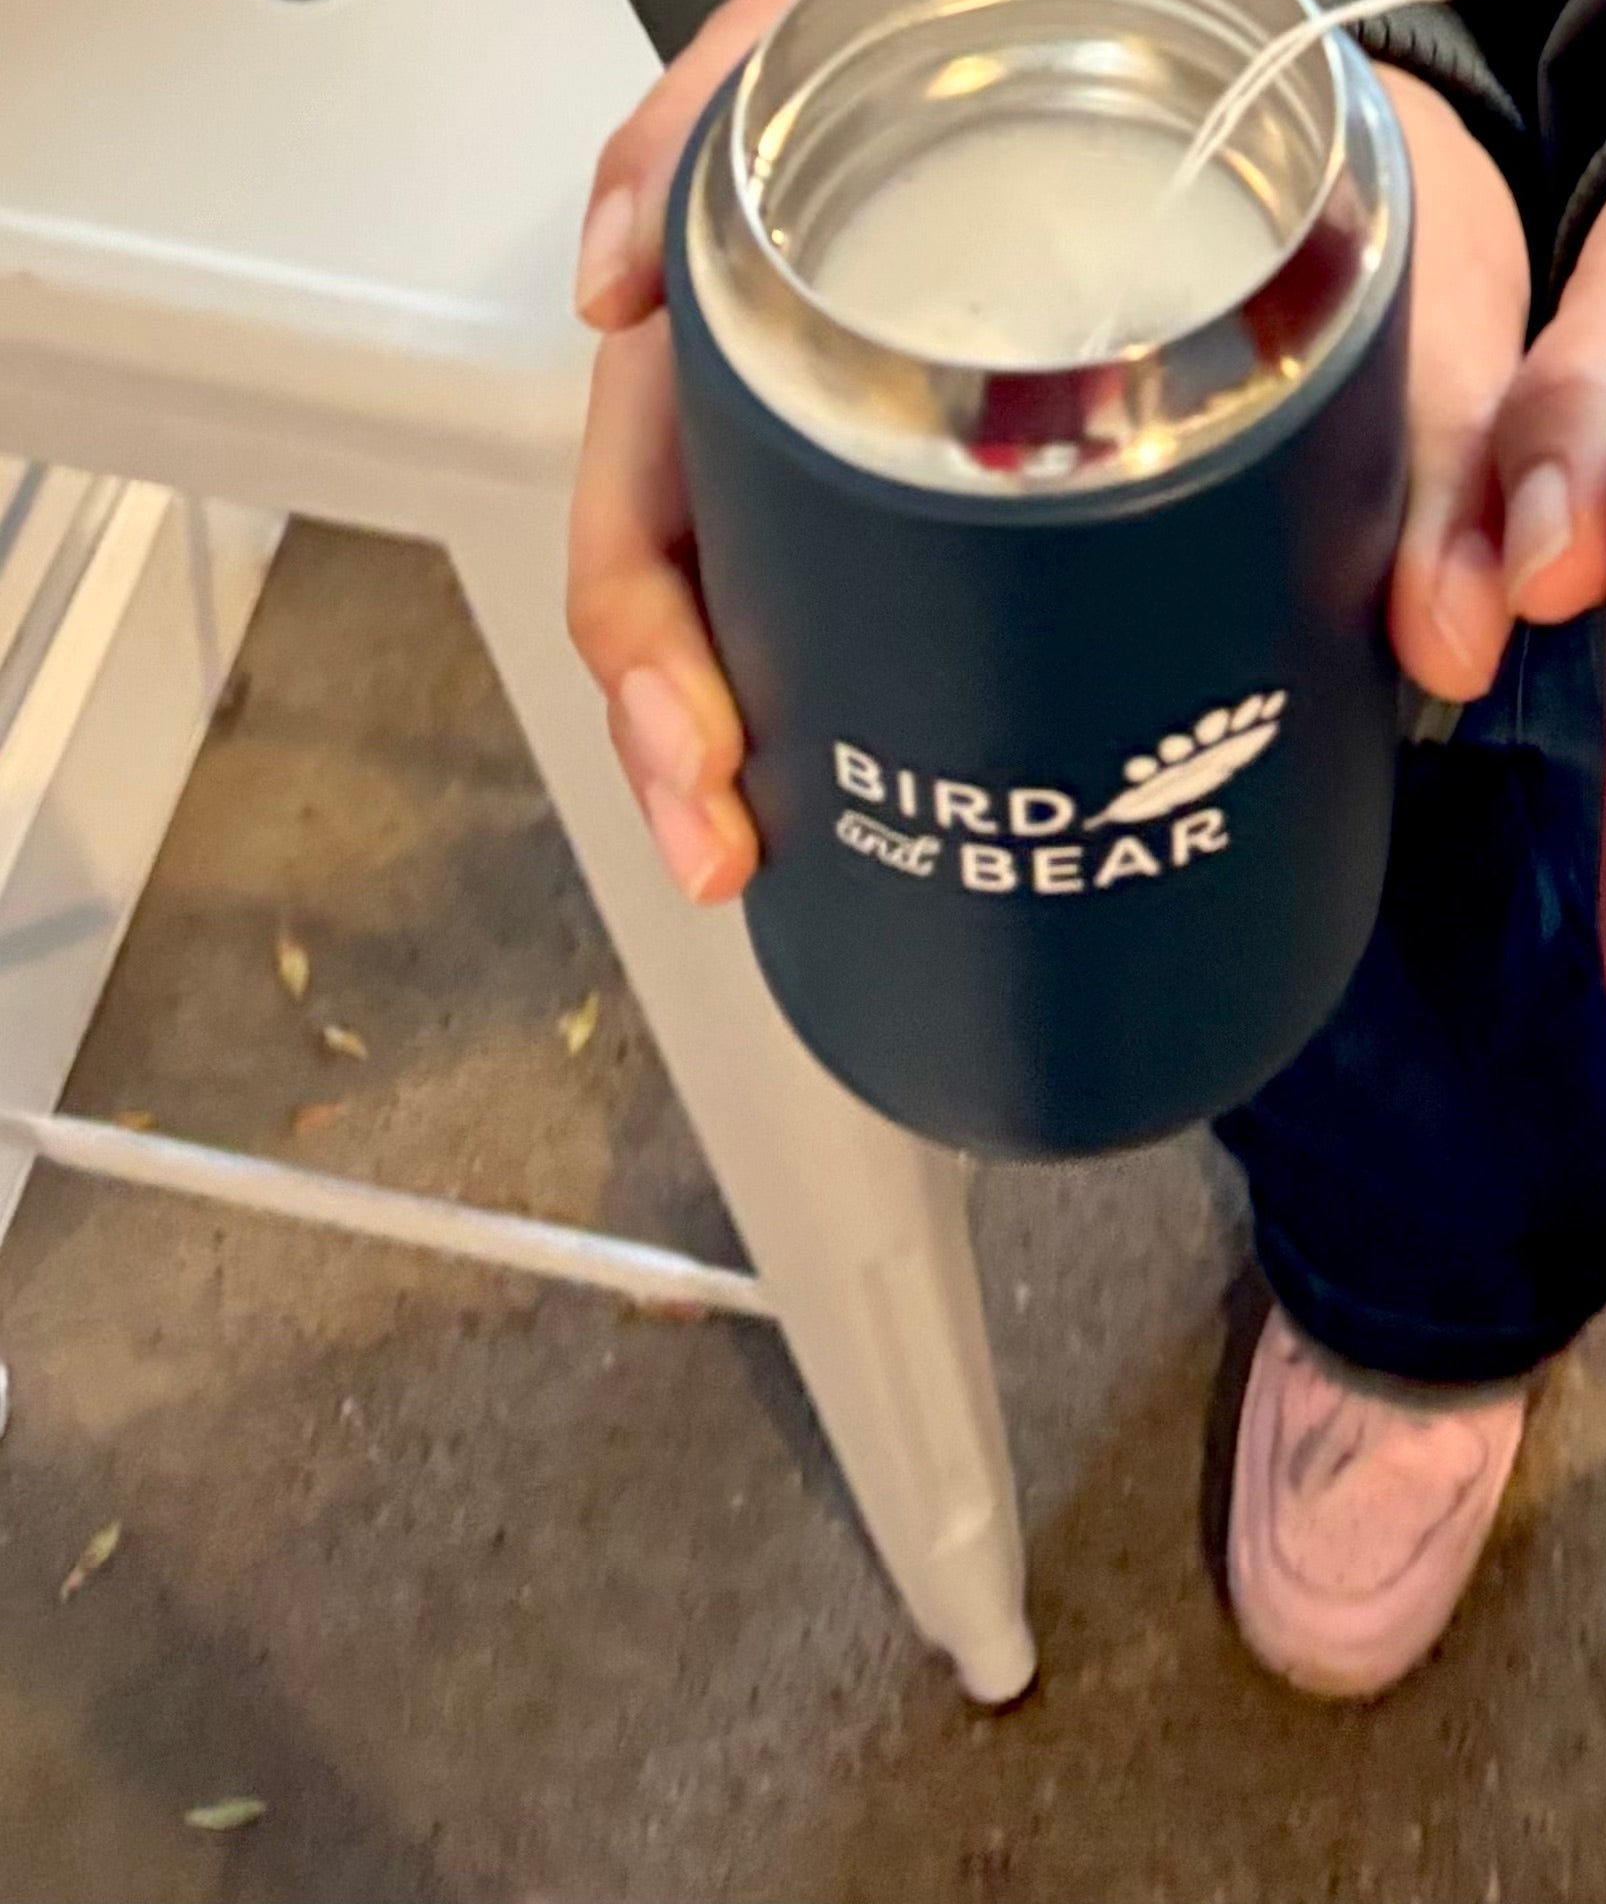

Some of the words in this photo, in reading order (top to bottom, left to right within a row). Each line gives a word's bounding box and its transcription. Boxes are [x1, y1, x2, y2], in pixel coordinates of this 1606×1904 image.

[833, 740, 1075, 837] BIRD
[836, 810, 941, 877] and
[960, 808, 1229, 894] BEAR
